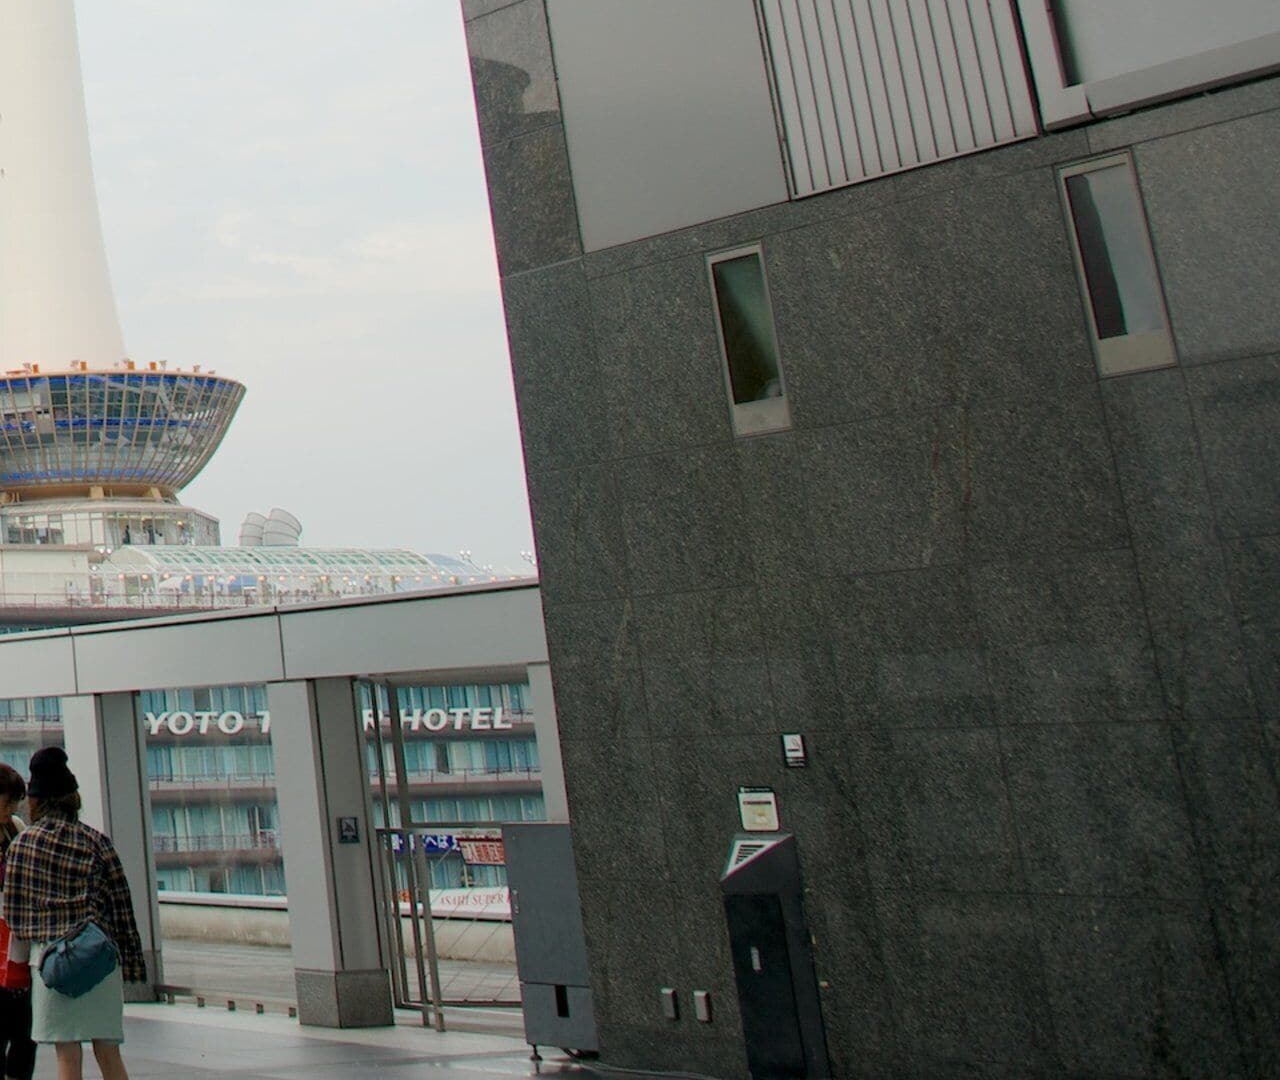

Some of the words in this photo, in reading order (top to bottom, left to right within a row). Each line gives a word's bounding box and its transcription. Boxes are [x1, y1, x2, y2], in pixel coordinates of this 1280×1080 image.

[144, 710, 244, 735] YOTO
[400, 707, 512, 731] HOTEL
[472, 892, 504, 905] SUPER
